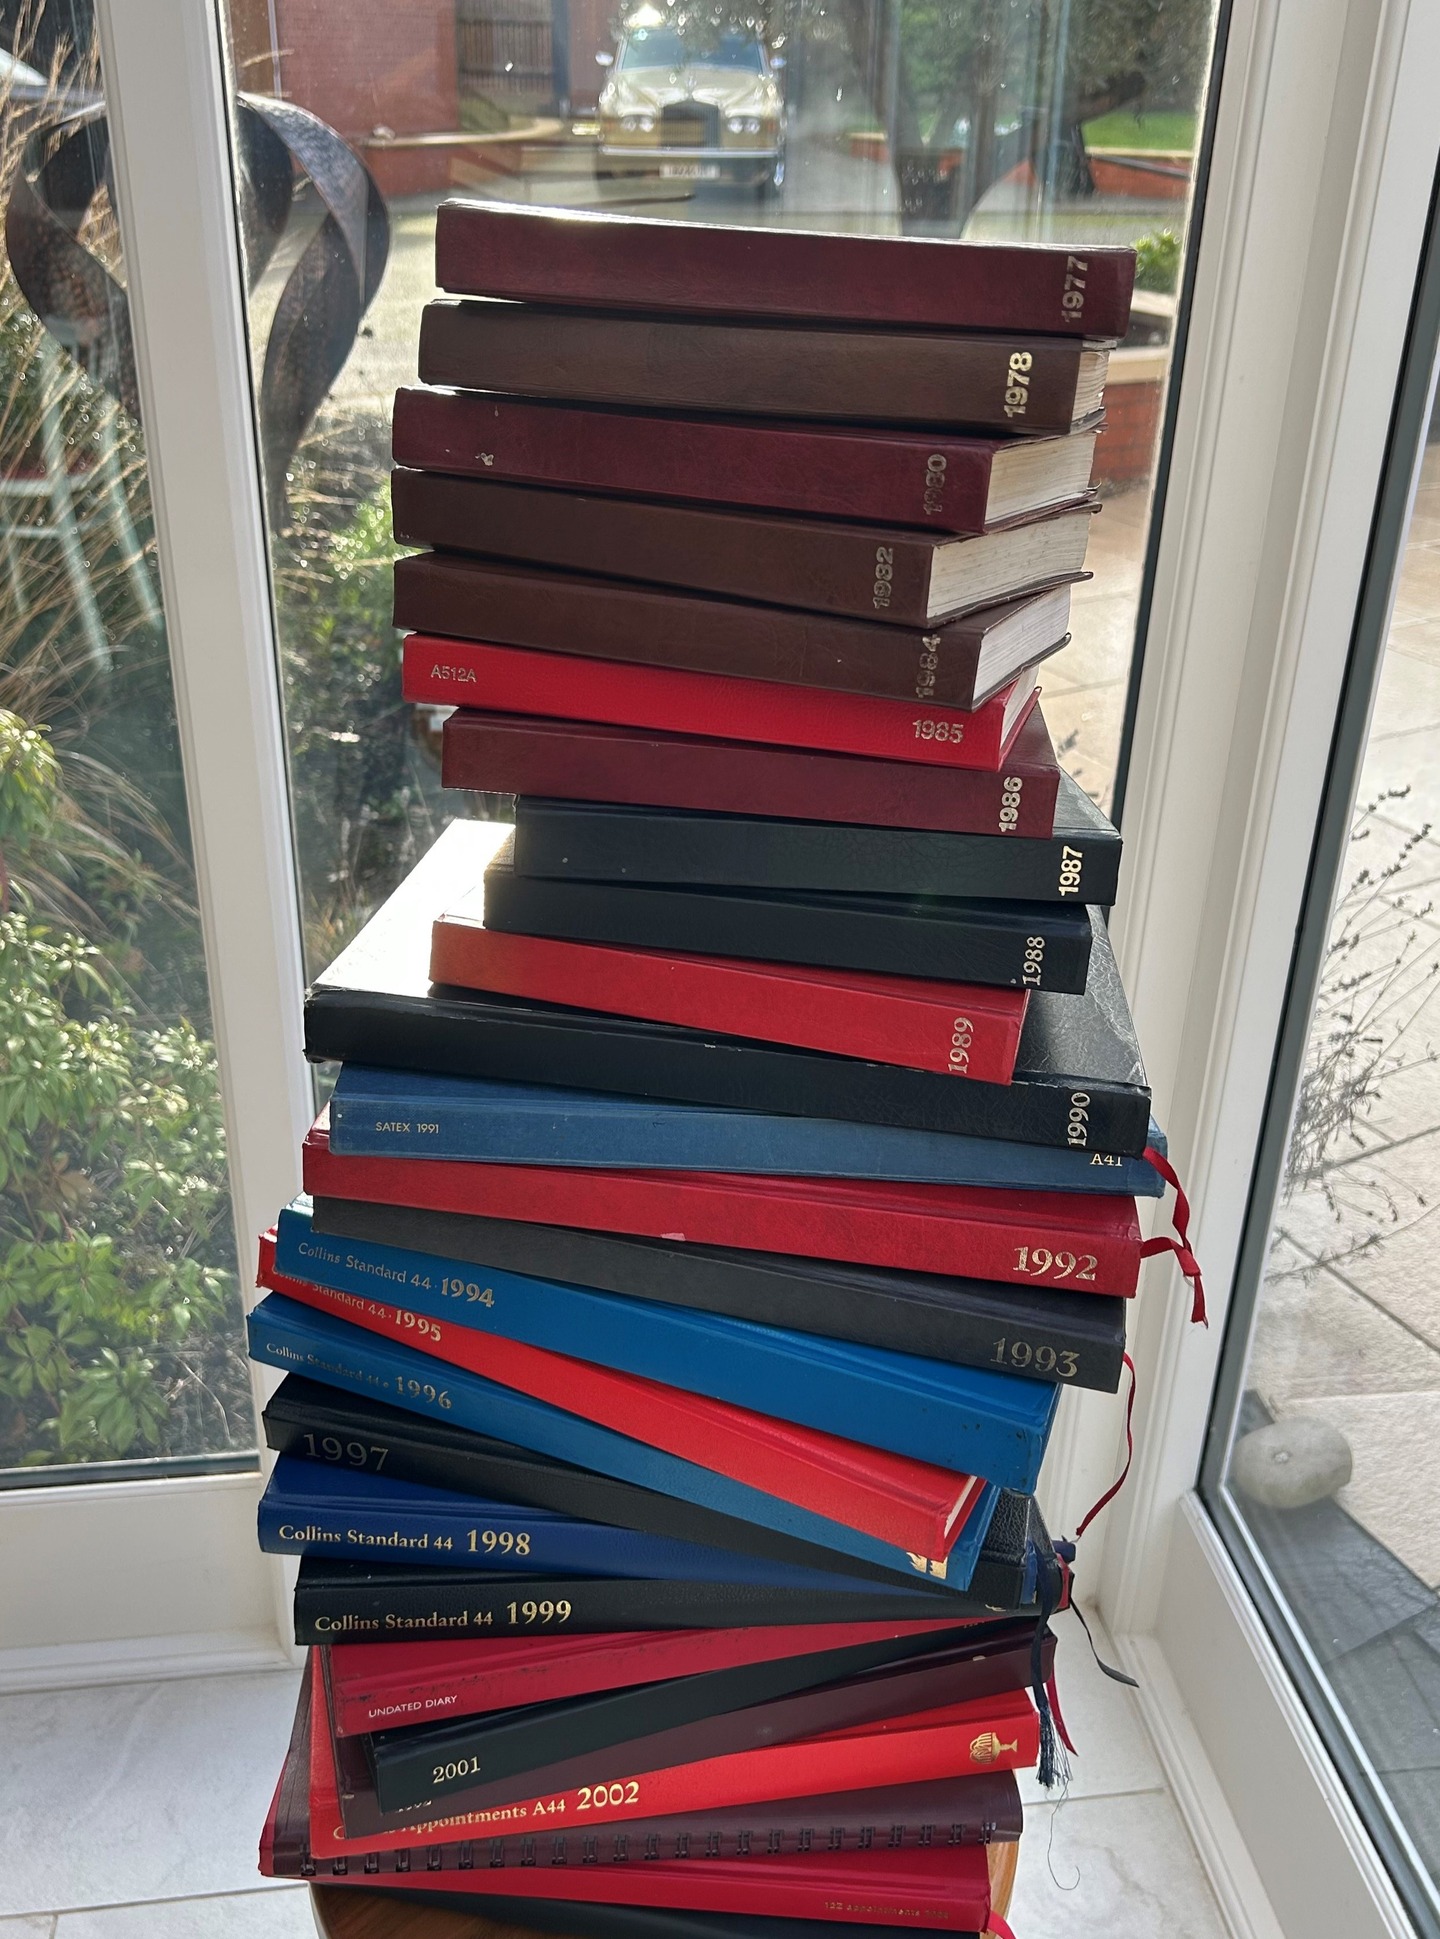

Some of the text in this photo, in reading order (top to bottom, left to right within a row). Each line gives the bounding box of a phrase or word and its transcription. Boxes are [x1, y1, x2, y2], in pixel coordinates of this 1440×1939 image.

[1061, 255, 1088, 322] 1977
[1003, 351, 1033, 417] 1978
[922, 454, 947, 515] 1980
[872, 546, 894, 608] 1982
[430, 664, 477, 683] A512A
[915, 633, 941, 698] 1984
[912, 719, 964, 743] 1985
[998, 776, 1023, 832] 1986
[1058, 846, 1083, 896] 1987
[1022, 936, 1045, 986] 1988
[948, 1017, 974, 1073] 1989
[375, 1121, 439, 1134] SATEX 1991
[1067, 1092, 1091, 1146] 1990
[298, 1242, 341, 1264] Collins
[345, 1254, 407, 1284] Standard
[441, 1277, 495, 1308] 1994
[1013, 1246, 1098, 1281] 1992
[395, 1309, 442, 1342] 1995
[266, 1342, 304, 1361] Collins
[306, 1353, 363, 1382] Standard
[394, 1375, 453, 1410] 1996
[990, 1337, 1080, 1378] 1993
[303, 1433, 389, 1471] 1997
[279, 1525, 531, 1555] Collins Standard 44 1998
[315, 1600, 572, 1632] Collins Standard 44 1999
[368, 1695, 457, 1718] UNDATED DIARY
[432, 1756, 480, 1784] 2001
[403, 1806, 527, 1834] ppointments
[532, 1799, 566, 1816] A44
[576, 1781, 640, 1810] 2002
